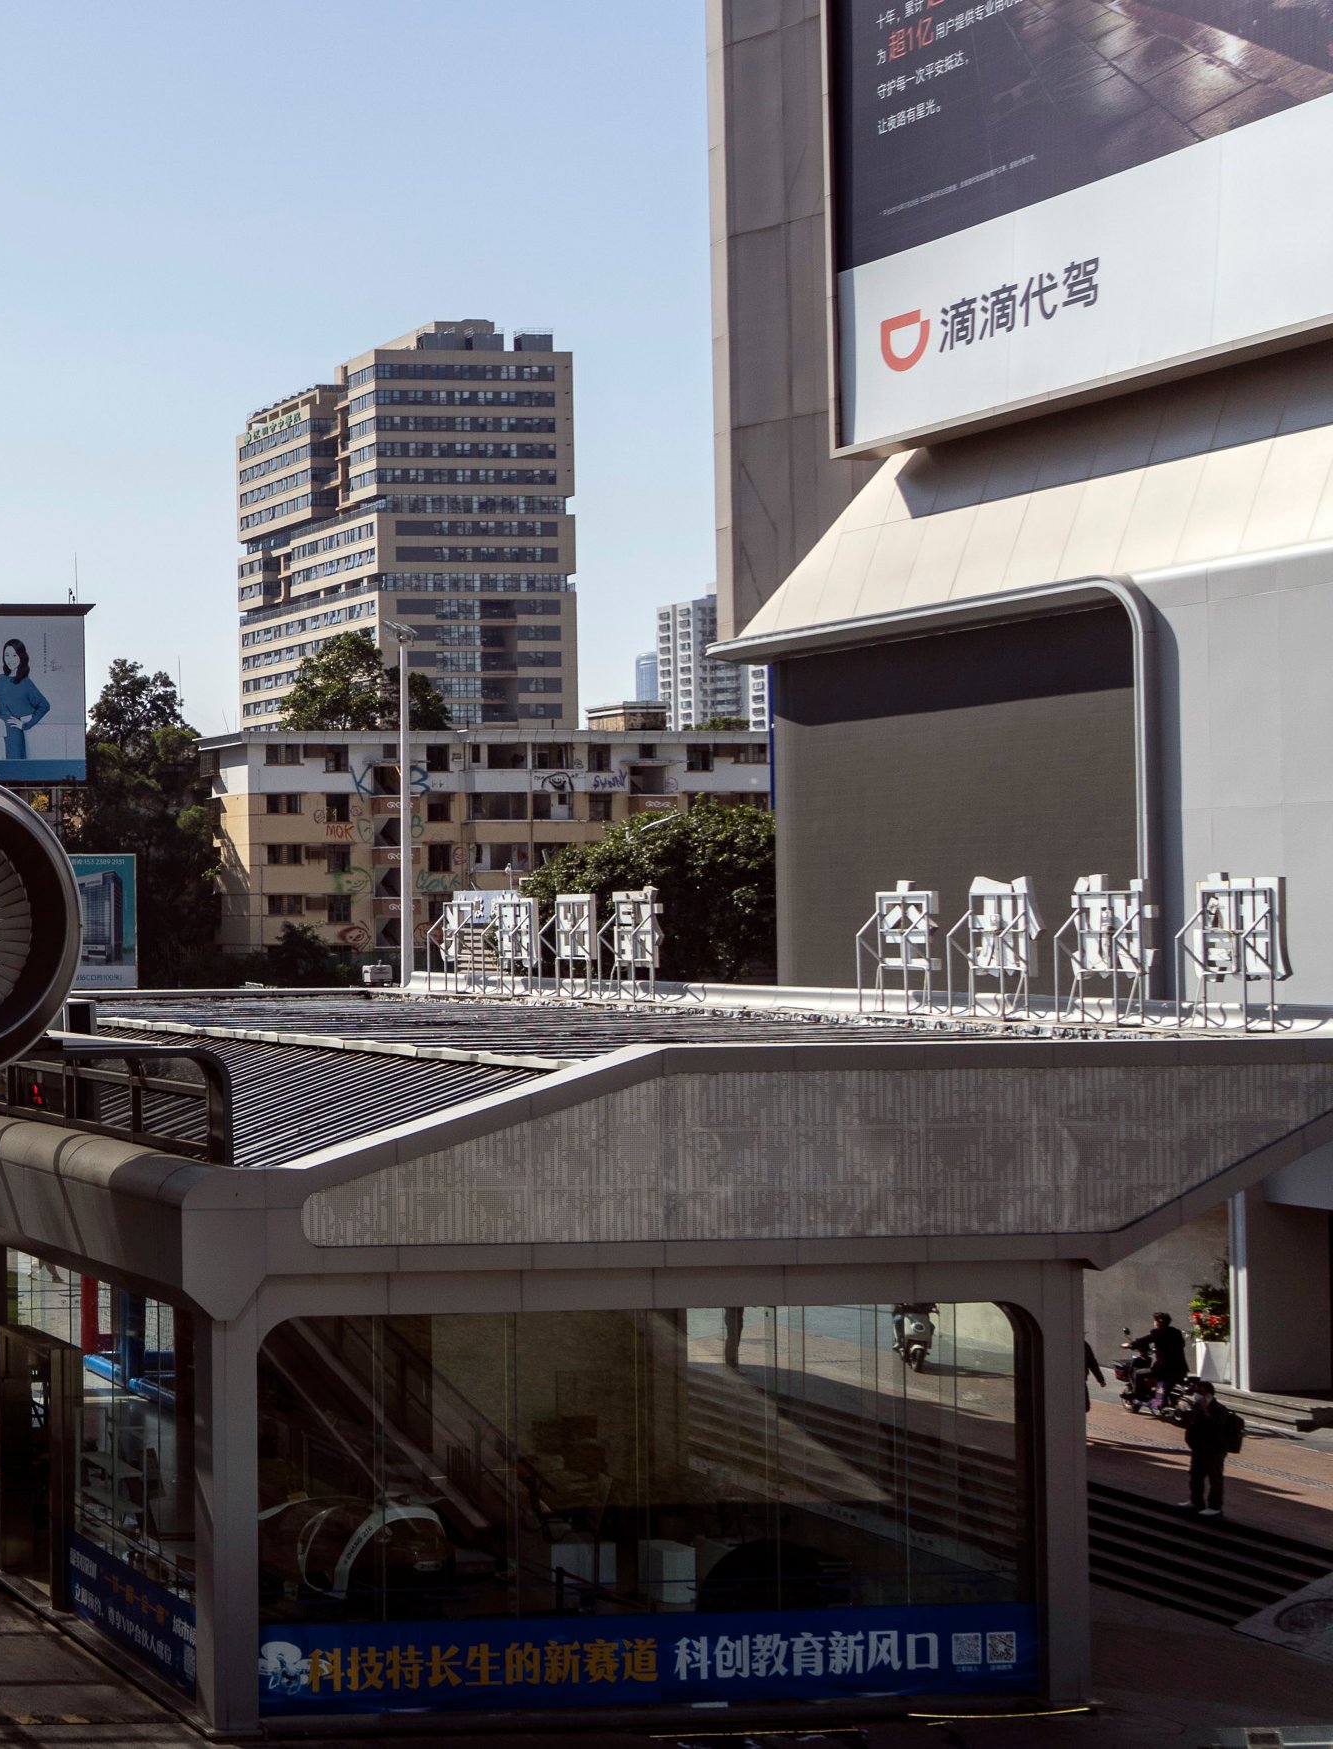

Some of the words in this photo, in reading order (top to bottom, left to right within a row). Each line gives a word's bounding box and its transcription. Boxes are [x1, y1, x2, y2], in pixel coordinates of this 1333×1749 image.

[876, 98, 941, 135] 让夜路有星光。
[939, 256, 1099, 354] 滴滴代驾
[306, 1637, 659, 1693] 科技特长生的新赛道
[673, 1630, 939, 1681] 科创教育新风口
